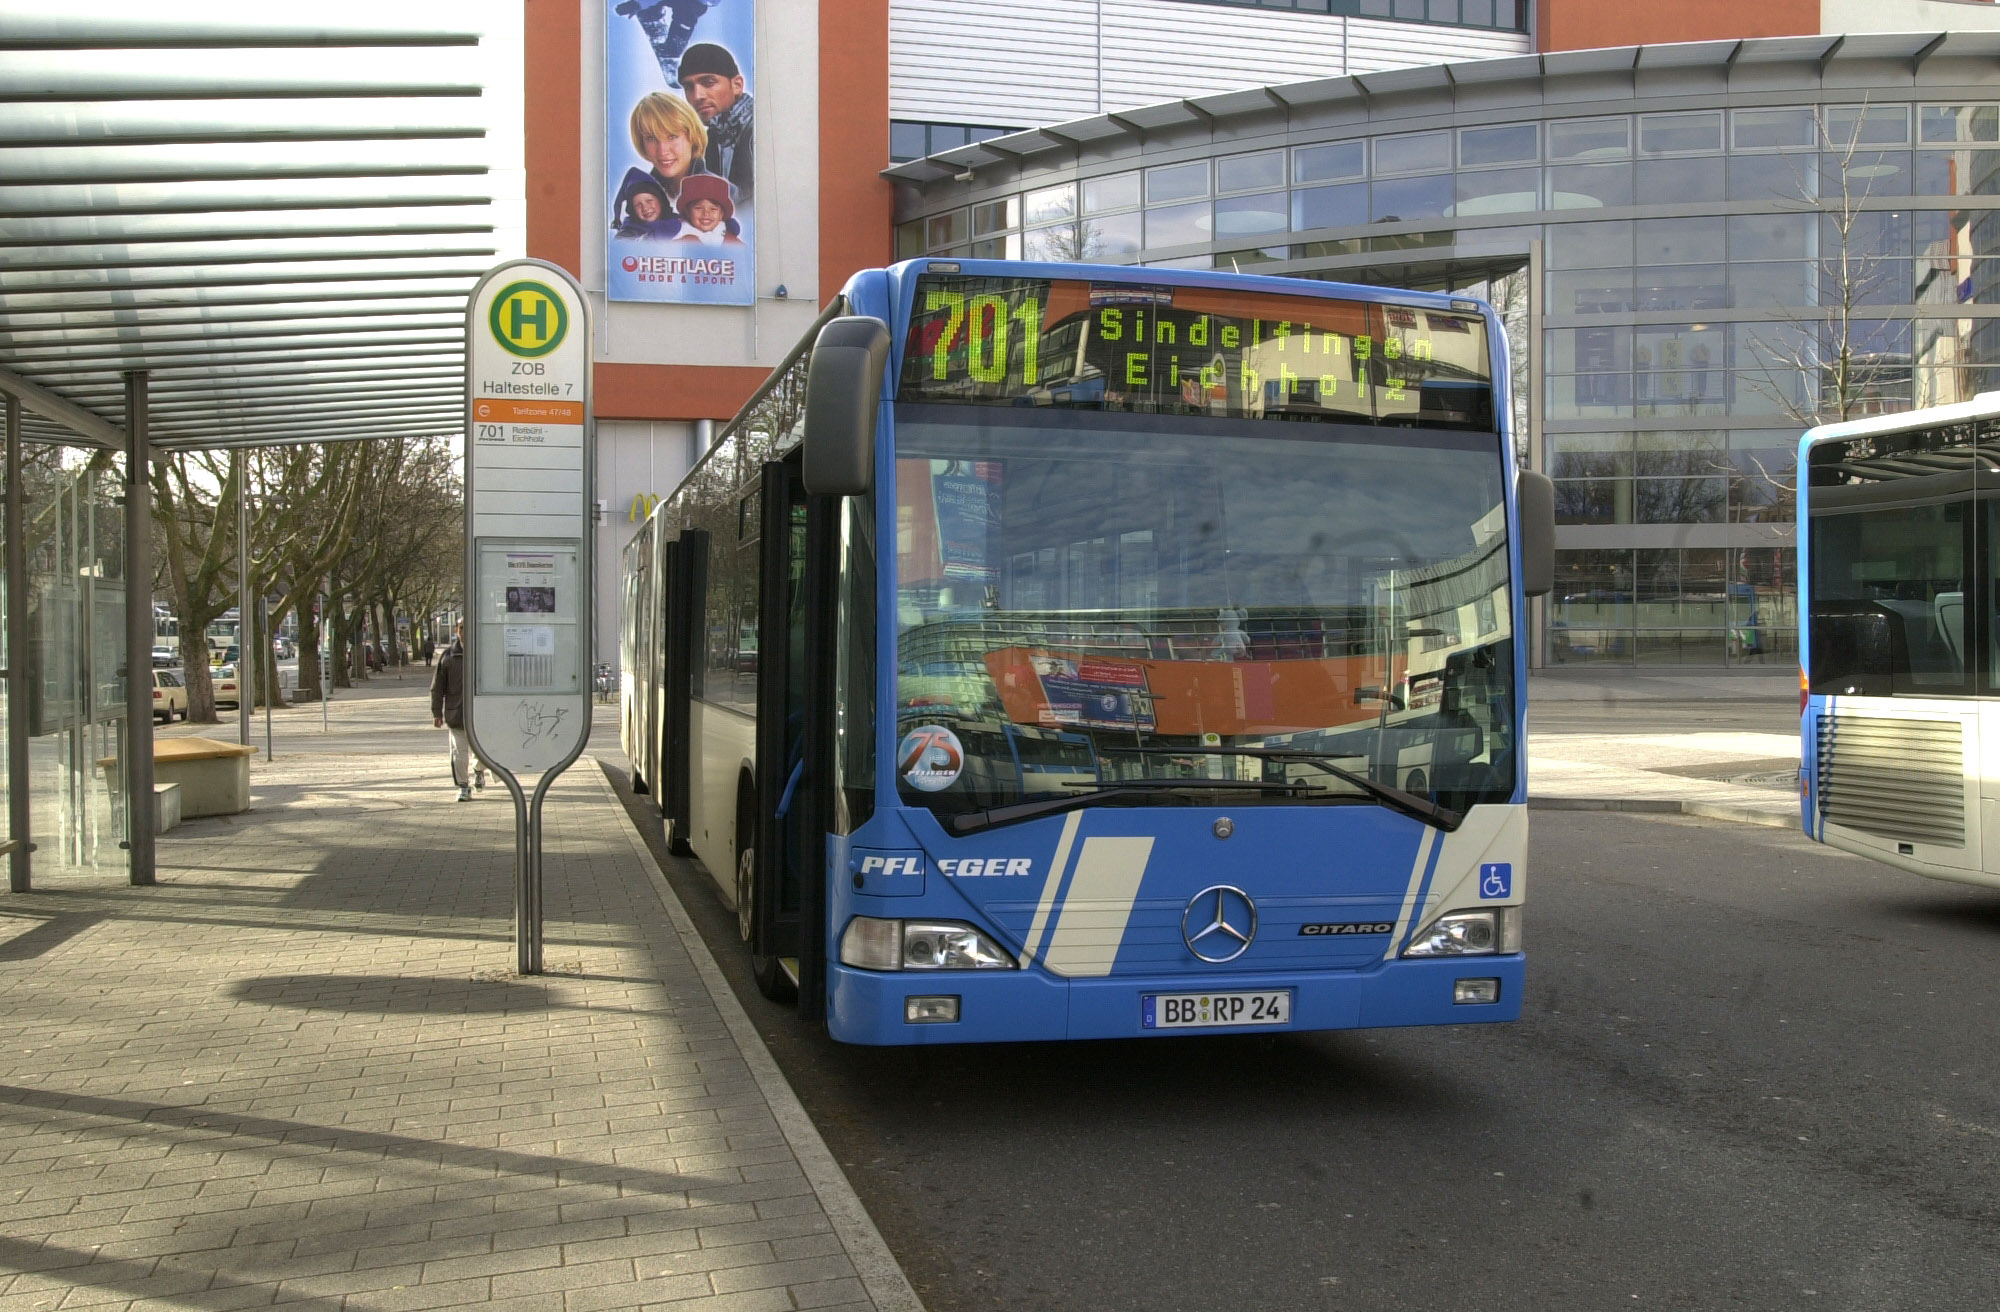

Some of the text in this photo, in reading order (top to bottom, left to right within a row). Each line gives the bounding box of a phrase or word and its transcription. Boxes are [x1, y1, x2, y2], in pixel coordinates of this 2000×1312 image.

[638, 256, 735, 277] HETTLAGE
[638, 274, 673, 283] MODE
[695, 276, 735, 285] SPORT
[511, 298, 547, 341] H
[926, 290, 1039, 385] 701
[1100, 308, 1433, 361] Sindelfingen
[511, 362, 545, 376] ZOB
[1126, 352, 1406, 401] Eichholz
[483, 381, 574, 396] Haltestelle 7
[512, 407, 547, 416] Tarifzone
[478, 424, 504, 438] 701
[900, 731, 961, 775] 75
[861, 856, 1032, 877] PFLEGER
[1302, 923, 1391, 935] CITARO
[1165, 998, 1197, 1023] BB
[1213, 997, 1244, 1022] RP
[1251, 996, 1280, 1020] 24
